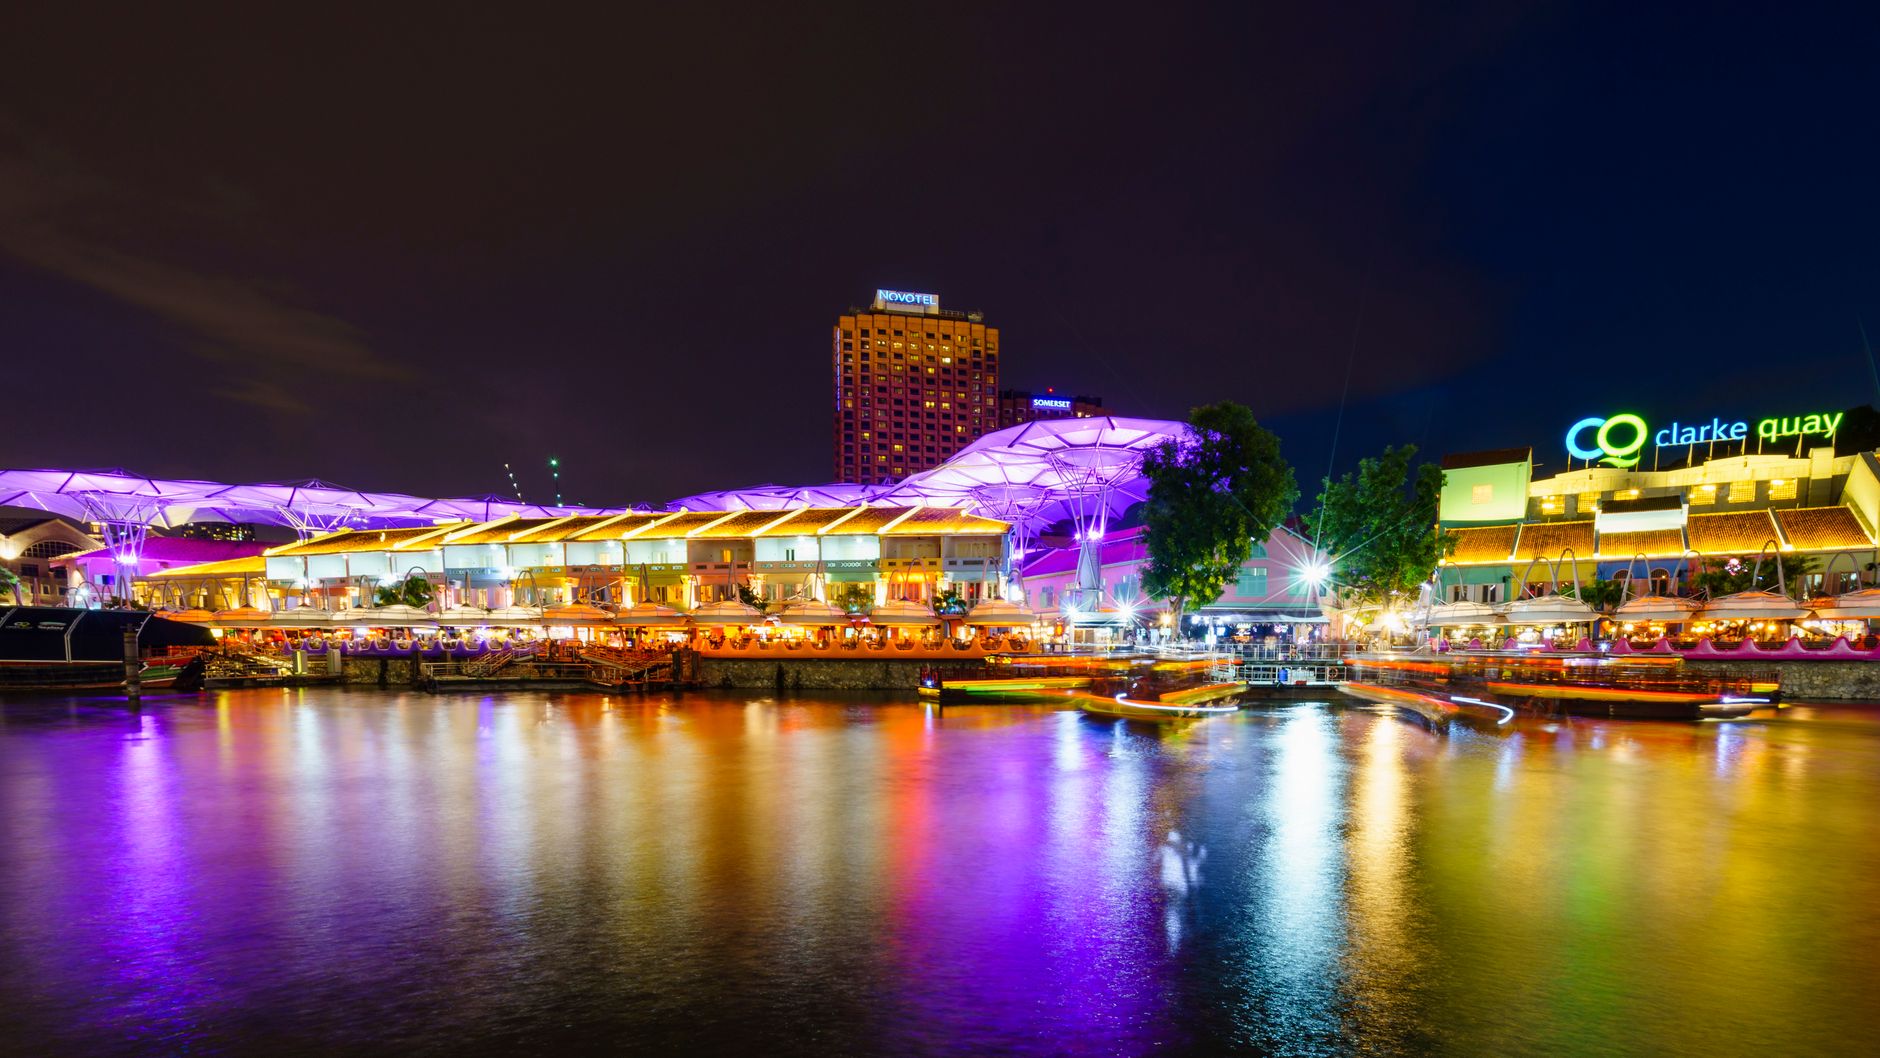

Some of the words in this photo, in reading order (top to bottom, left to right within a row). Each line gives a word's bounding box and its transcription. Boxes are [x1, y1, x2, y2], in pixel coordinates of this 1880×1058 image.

[879, 289, 936, 305] NOVOTEL
[1033, 398, 1070, 408] SOMERSET
[1655, 418, 1747, 447] clarke
[1758, 412, 1843, 443] quay
